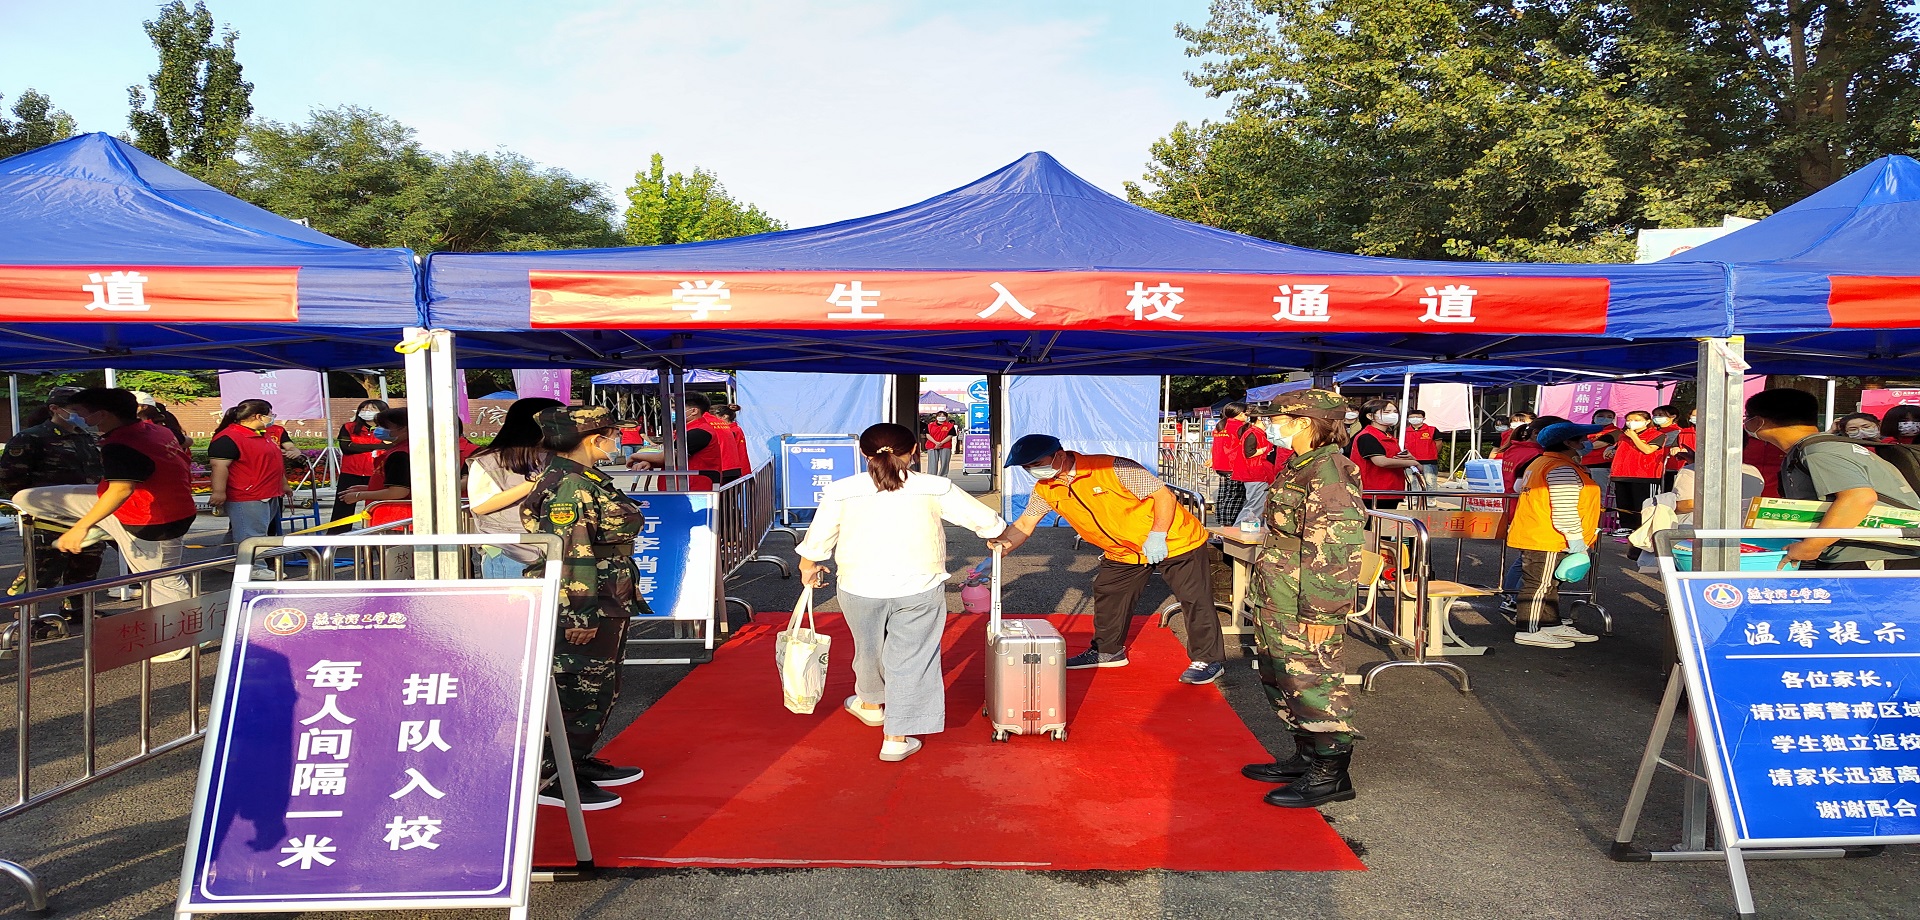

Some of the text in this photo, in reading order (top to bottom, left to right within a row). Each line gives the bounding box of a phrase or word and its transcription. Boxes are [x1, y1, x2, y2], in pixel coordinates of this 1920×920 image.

[82, 271, 151, 312] 道
[671, 279, 1478, 323] 学生入校通道
[1744, 620, 1906, 649] 温馨提示
[1771, 733, 1920, 754] 学生独立返校
[276, 659, 363, 870] 每人间隔一米
[383, 673, 459, 851] 排队入校
[1768, 766, 1920, 787] 请家长迅速离
[1816, 799, 1918, 820] 谢谢配合
